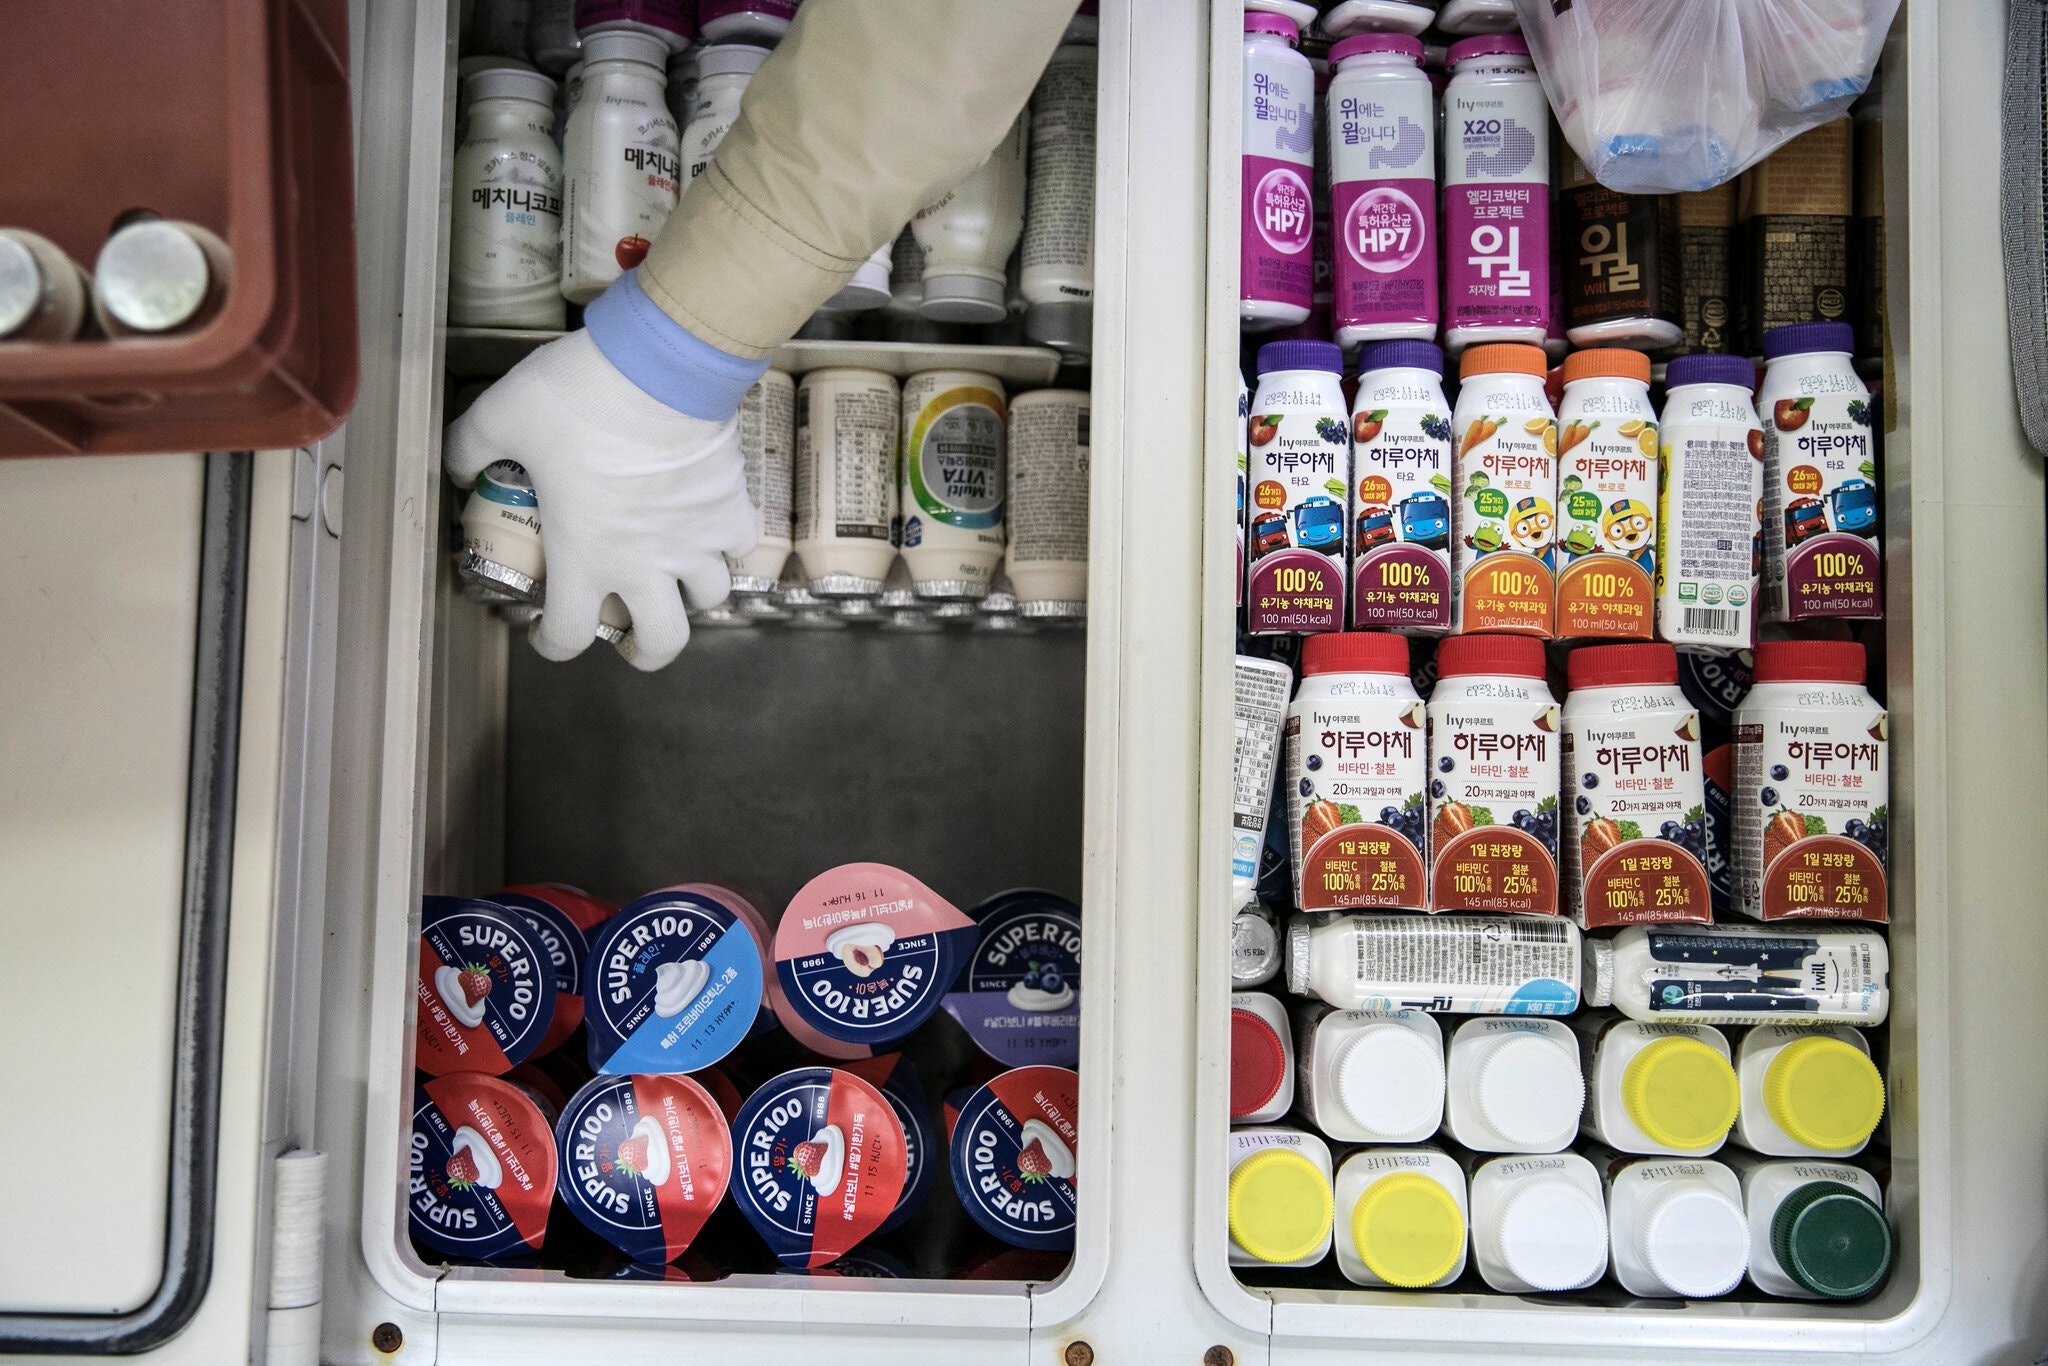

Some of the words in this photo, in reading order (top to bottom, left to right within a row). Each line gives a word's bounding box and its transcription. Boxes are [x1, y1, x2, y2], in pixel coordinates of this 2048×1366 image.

[1253, 72, 1290, 100] 위에는
[1253, 97, 1297, 125] 윌입니다
[1340, 97, 1385, 120] 위에는
[1340, 122, 1396, 145] 윌입니다
[1276, 183, 1296, 197] 위건강
[1466, 189, 1530, 205] 헬리코박터
[1264, 192, 1306, 214] 특허유산균
[1371, 202, 1397, 214] 위건강
[1264, 205, 1306, 236] HP7
[1357, 213, 1412, 229] 특허유산균
[1472, 205, 1525, 220] 프로젝트
[1358, 227, 1412, 253] HP7
[1468, 225, 1531, 297] 윌
[1579, 221, 1641, 293] 윌
[1468, 284, 1498, 296] 저지방
[1797, 435, 1867, 458] 하루야채
[1265, 452, 1334, 474] 하루야채
[1370, 447, 1439, 470] 하루야채
[1482, 454, 1550, 479] 하루야채
[1826, 460, 1845, 471] 타요
[941, 466, 986, 484] VITA
[1396, 471, 1416, 482] 타요
[1575, 458, 1647, 481] 하루야채
[1291, 476, 1310, 486] 타요
[1504, 479, 1532, 490] 뽀로로
[1597, 482, 1626, 492] 뽀로로
[947, 484, 986, 498] Multi
[1813, 552, 1864, 578] 100%
[1273, 567, 1324, 593] 100%
[1378, 562, 1430, 587] 100%
[1490, 571, 1539, 596] 100%
[1582, 573, 1634, 599] 100%
[1800, 581, 1832, 595] 유기농
[1834, 581, 1874, 595] 야채과일
[1259, 595, 1289, 610] 유기농
[1292, 595, 1333, 610] 야채과일
[1365, 591, 1396, 604] 유기농
[1399, 591, 1440, 604] 야채과일
[1802, 599, 1822, 610] 100
[1823, 599, 1850, 611] ml(50
[1851, 597, 1874, 610] kcal)
[1367, 608, 1385, 618] 100
[1386, 607, 1414, 620] ml(50
[1414, 607, 1438, 620] kcal)
[1475, 599, 1505, 612] 유기농
[1508, 601, 1548, 615] 야채과일
[1567, 602, 1599, 615] 유기농
[1602, 603, 1644, 617] 야채과일
[1261, 614, 1279, 624] 100
[1280, 613, 1308, 625] ml(50
[1309, 613, 1332, 626] kcal)
[1479, 616, 1496, 626] 100
[1571, 618, 1589, 629] 100
[1590, 618, 1616, 630] ml(50
[1616, 618, 1639, 632] kcal)
[1320, 730, 1412, 759] 하루야채
[1453, 733, 1546, 763] 하루야채
[1596, 744, 1690, 775] 하루야채
[1787, 741, 1879, 771] 하루야채
[1332, 783, 1361, 796] 20가지
[1362, 786, 1385, 796] 과일과
[1386, 786, 1402, 796] 야채
[1495, 788, 1519, 798] 과일과
[1519, 788, 1536, 799] 야채
[1640, 801, 1665, 812] 과일과
[1665, 800, 1682, 811] 야채
[1828, 797, 1851, 808] 과일과
[1852, 798, 1868, 808] 야채
[1338, 841, 1357, 855] 1일
[1358, 841, 1391, 856] 권장량
[1470, 843, 1487, 857] 1일
[1489, 843, 1523, 858] 권장량
[1325, 860, 1351, 872] 비타민
[1350, 860, 1358, 872] C
[1379, 860, 1398, 873] 철분
[1456, 862, 1482, 875] 비타민
[1482, 862, 1490, 874] C
[1620, 857, 1637, 871] 1일
[1638, 856, 1673, 871] 권장량
[1803, 852, 1821, 866] 1일
[1822, 852, 1855, 868] 권장량
[1511, 864, 1530, 876] 철분
[1789, 871, 1815, 883] 비타민
[1815, 872, 1822, 883] C
[1843, 872, 1861, 885] 철분
[1322, 873, 1355, 891] 100%
[1371, 873, 1399, 891] 25%
[1453, 875, 1486, 894] 100%
[1503, 876, 1531, 895] 25%
[1607, 876, 1634, 889] 비타민
[1634, 877, 1641, 888] C
[1662, 875, 1681, 888] 철분
[855, 890, 867, 902] 16
[1332, 894, 1350, 905] 145
[1378, 894, 1400, 906] kcal)
[1463, 897, 1481, 908] 145
[1509, 896, 1532, 909] kcal)
[1605, 889, 1638, 909] 100%
[1655, 888, 1684, 907] 25%
[1786, 884, 1818, 903] 100%
[1835, 885, 1863, 903] 25%
[802, 907, 867, 930] #복숭아한가득
[1617, 911, 1635, 922] 145
[1635, 910, 1663, 922] ml(85
[1663, 909, 1686, 921] kcal)
[1840, 906, 1863, 919] kcal)
[897, 938, 927, 950] SINCE
[631, 943, 662, 974] 플레인
[802, 957, 825, 969] 1988
[626, 1004, 651, 1031] SINCE
[696, 931, 717, 952] 1988
[1811, 962, 1826, 985] will
[430, 934, 453, 962] SINCE
[490, 1018, 508, 1042] 1988
[855, 978, 888, 996] 복숭아
[979, 979, 1008, 989] SINCE
[659, 1029, 679, 1051] 특허
[676, 982, 724, 1034] 프로바이오틱스
[721, 968, 739, 986] 2종
[430, 1003, 470, 1056] #딸기한가득
[704, 1025, 716, 1039] 13
[623, 1091, 636, 1115] 1988
[430, 1111, 448, 1133] 1988
[468, 1098, 507, 1149] #딸기한가득
[662, 1095, 684, 1152] #딸기한가득
[995, 1107, 1015, 1129] 1988
[849, 1112, 866, 1170] #딸기한가득
[802, 1193, 815, 1225] SINCE
[816, 1095, 827, 1120] 1988
[866, 1160, 878, 1176] 15
[484, 1192, 506, 1222] SINCE
[643, 1187, 657, 1218] SINCE
